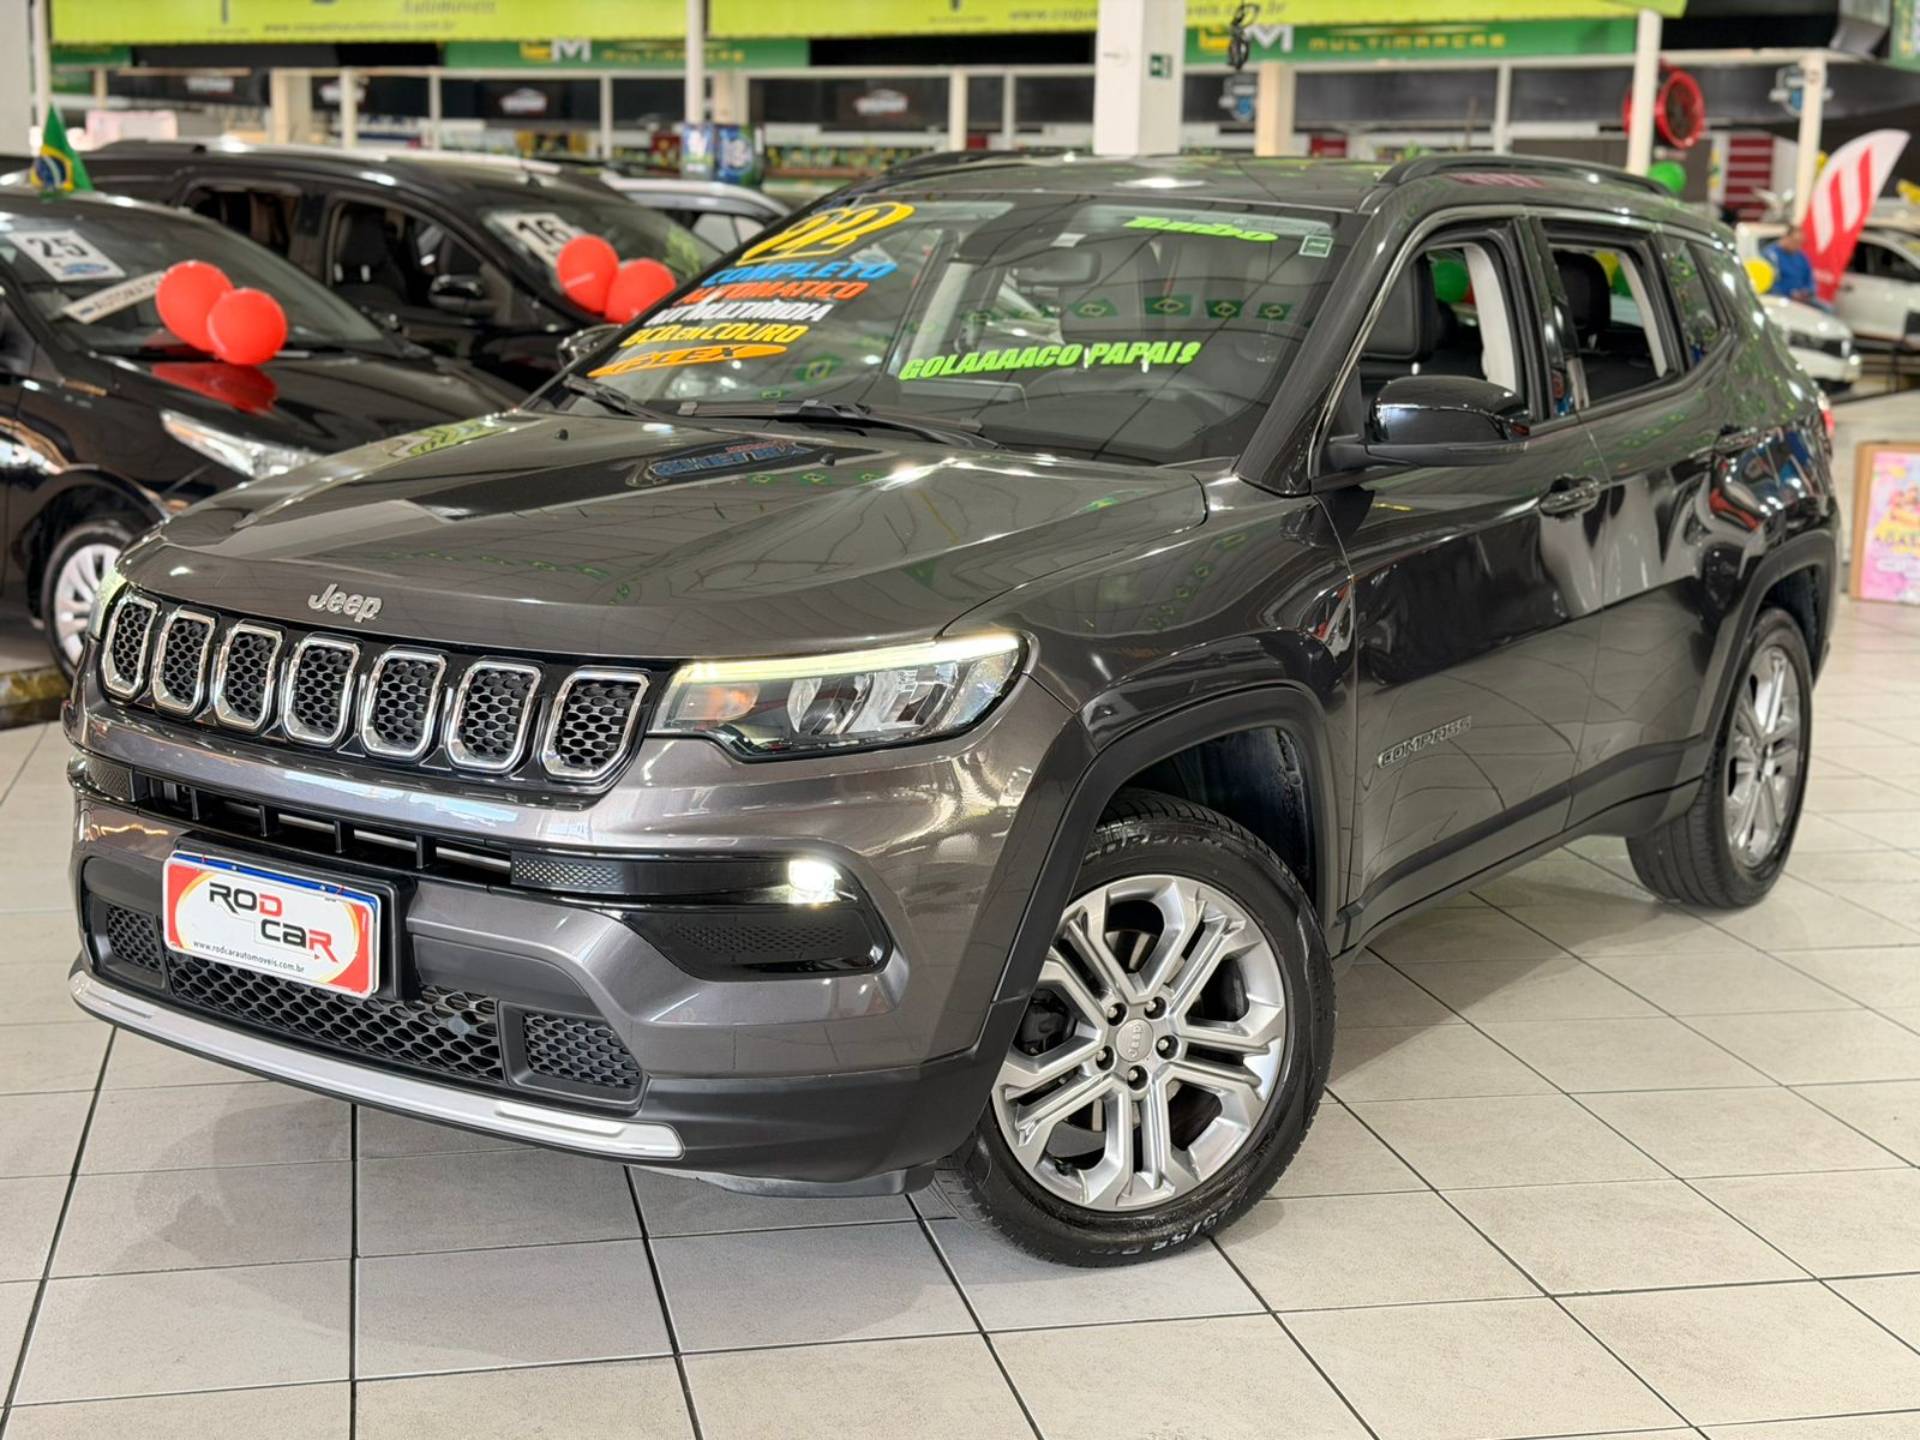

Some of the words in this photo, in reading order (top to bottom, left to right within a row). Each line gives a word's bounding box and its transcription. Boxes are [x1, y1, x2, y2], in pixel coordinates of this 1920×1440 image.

[27, 236, 88, 258] 25
[735, 202, 916, 267] 22
[701, 261, 899, 288] COMPLETO
[673, 281, 870, 306] AUTOMATICO
[700, 322, 810, 345] COURO
[307, 583, 383, 624] Jeep
[208, 881, 283, 918] ROD
[193, 940, 305, 973] www.rodcarautomoveis.com.br
